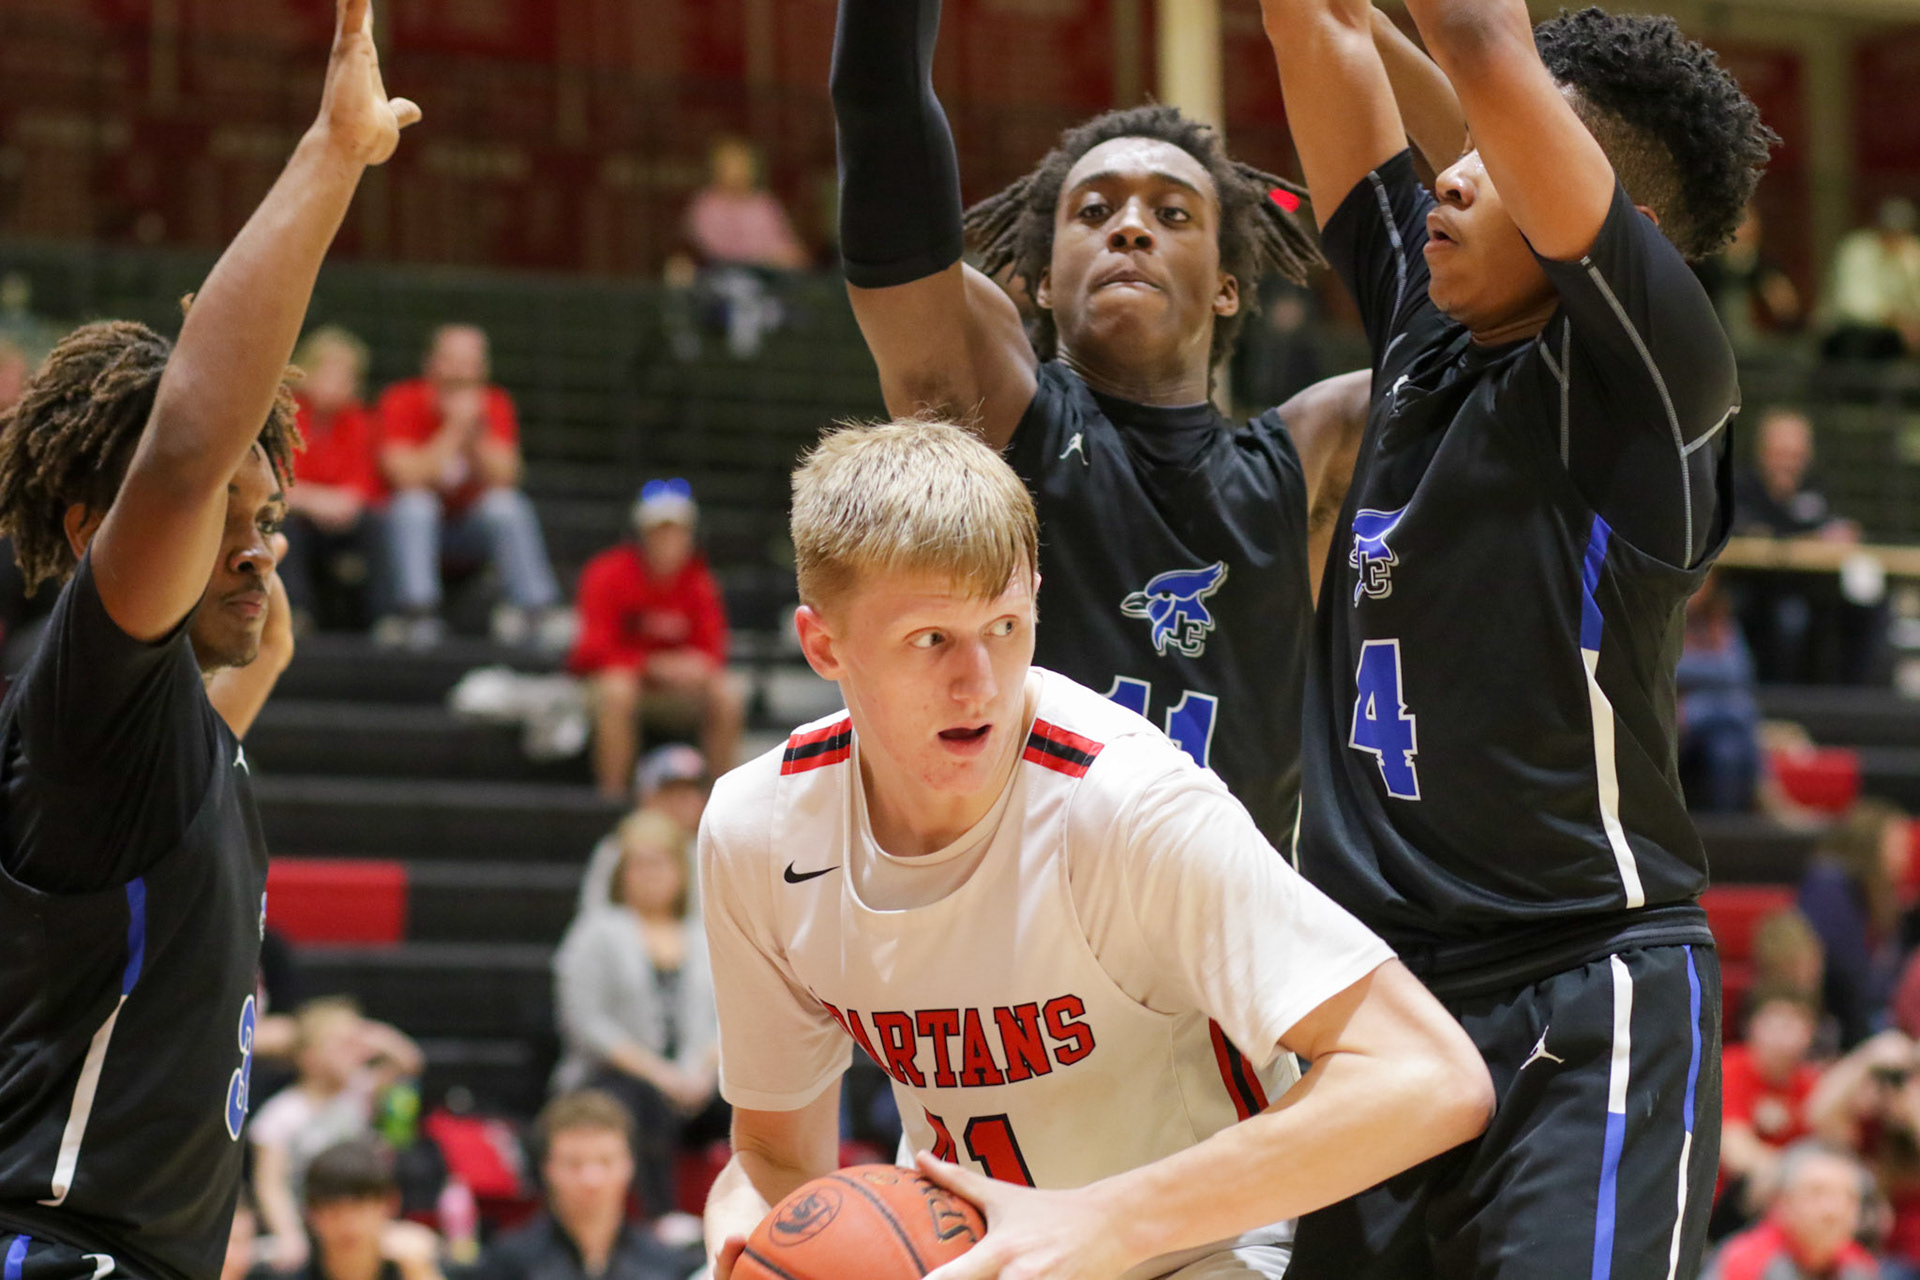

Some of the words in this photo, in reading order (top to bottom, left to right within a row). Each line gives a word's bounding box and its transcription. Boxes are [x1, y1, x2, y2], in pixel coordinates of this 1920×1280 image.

[1348, 638, 1421, 801] 4
[819, 993, 1096, 1089] RTANS
[923, 1106, 1037, 1189] 1
